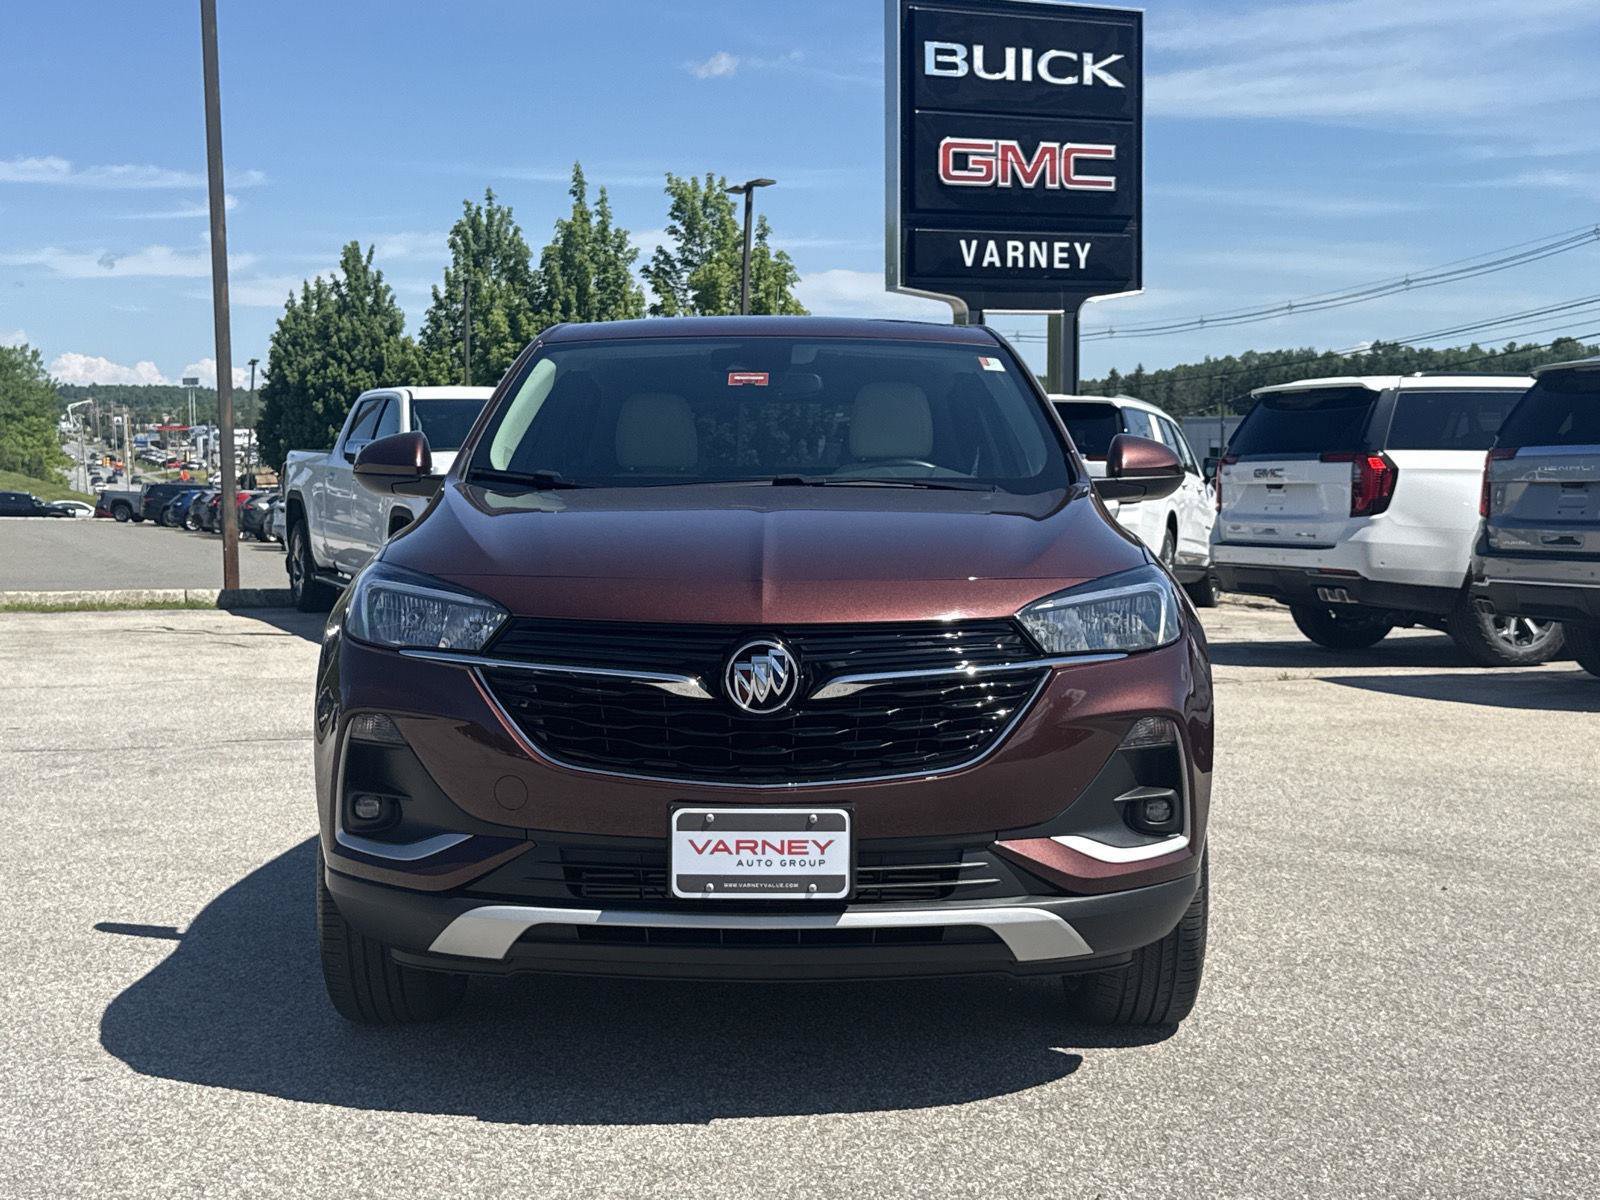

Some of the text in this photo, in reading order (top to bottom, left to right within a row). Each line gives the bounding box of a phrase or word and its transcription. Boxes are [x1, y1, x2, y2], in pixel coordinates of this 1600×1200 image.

[923, 40, 1126, 88] BUICK
[938, 136, 1117, 192] GMC
[959, 239, 1092, 270] VARNEY
[1253, 468, 1285, 479] GMC
[688, 839, 835, 855] VARNEY
[736, 859, 826, 867] AUTO GROUP
